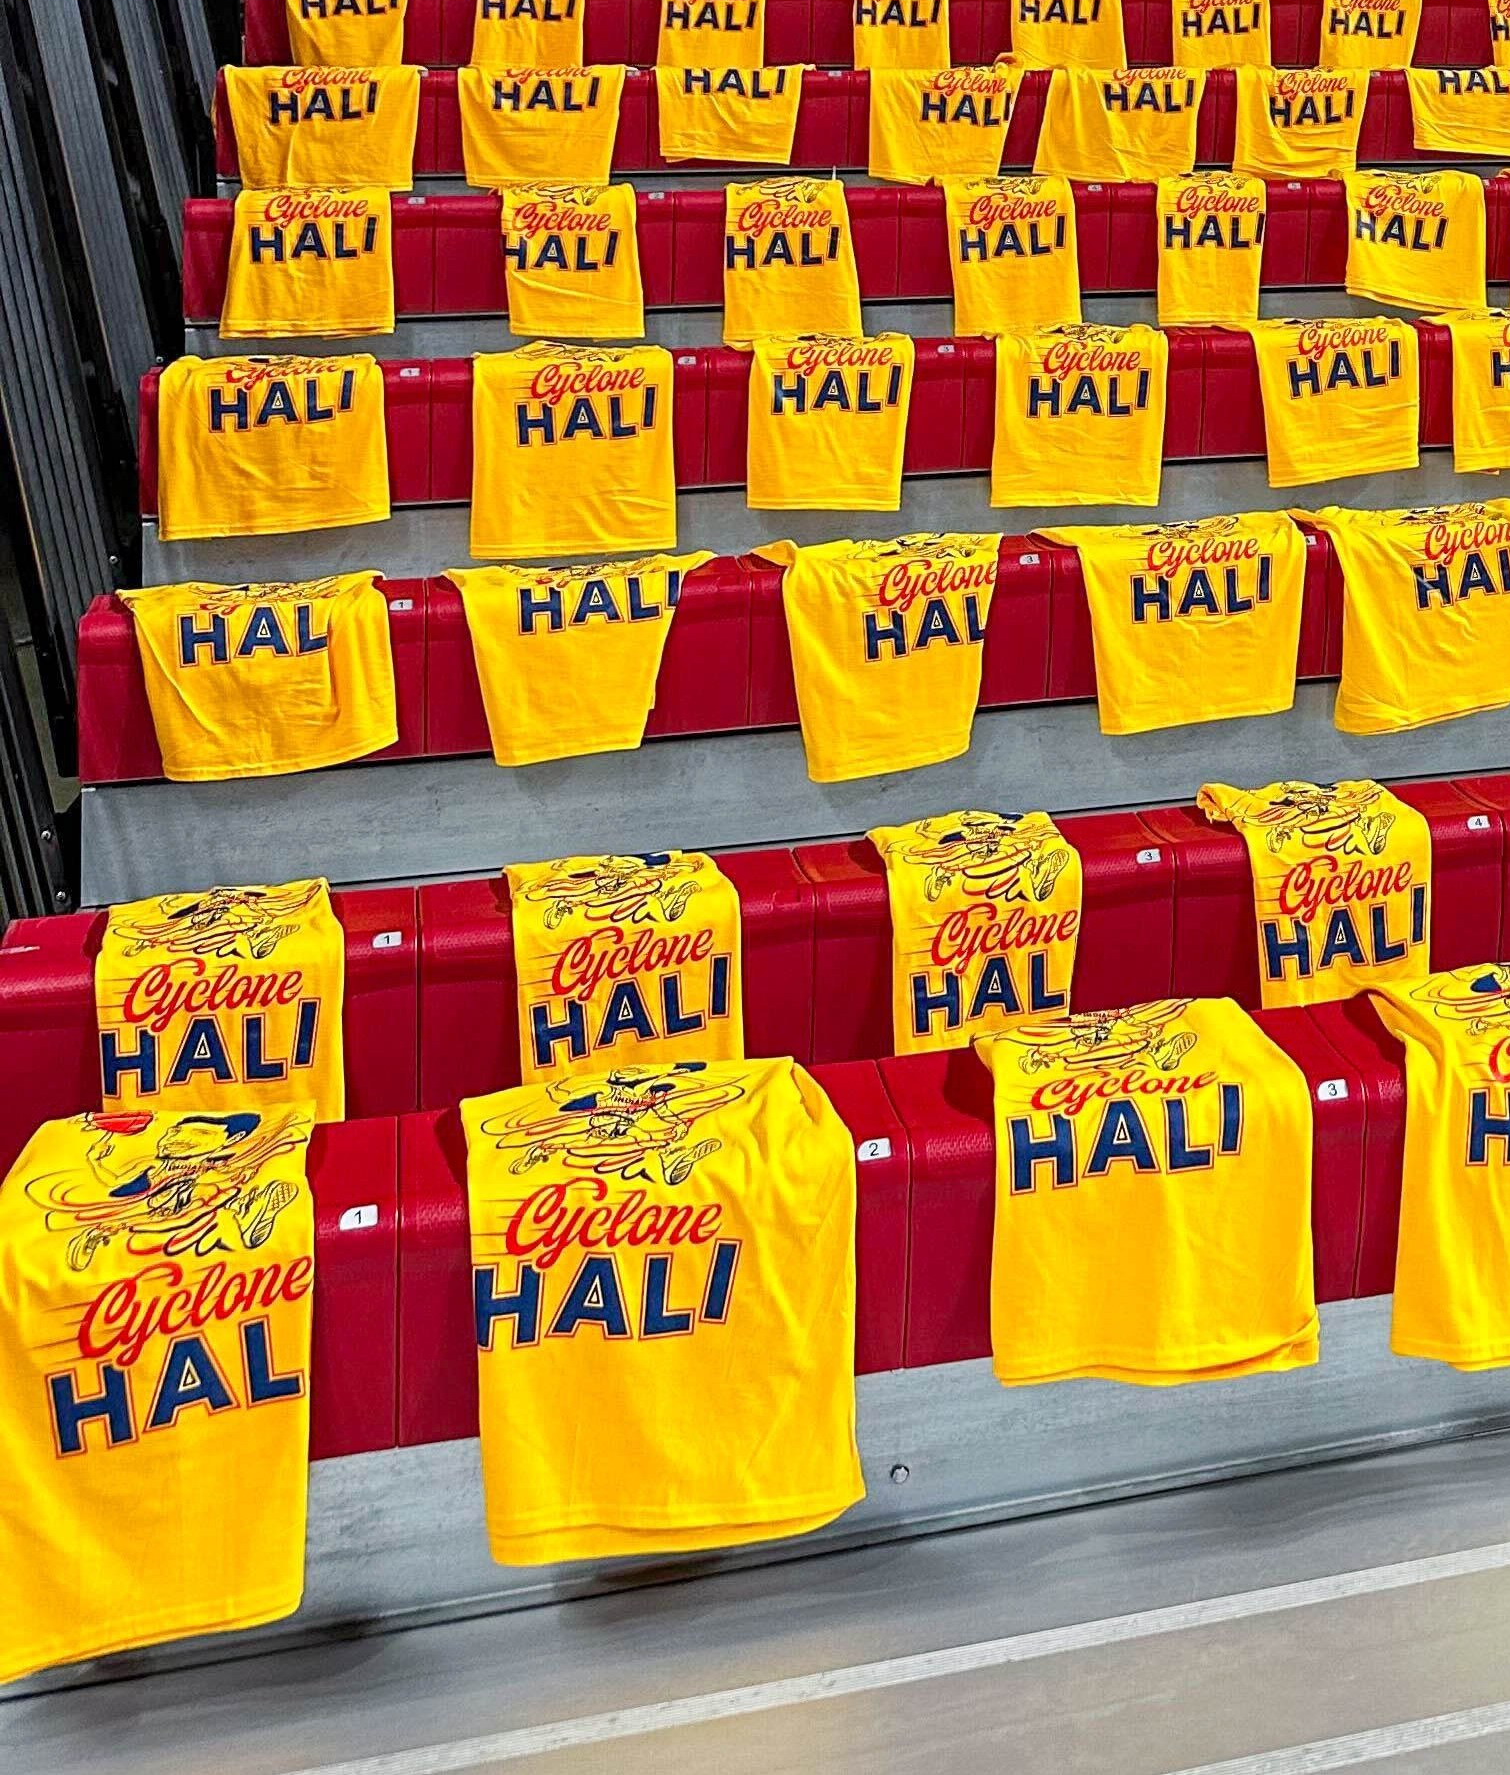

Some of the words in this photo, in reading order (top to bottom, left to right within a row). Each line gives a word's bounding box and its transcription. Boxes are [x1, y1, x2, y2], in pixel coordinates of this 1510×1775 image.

[667, 3, 756, 30] HALI
[494, 80, 598, 111] HALI
[685, 68, 785, 98] HALI
[1104, 83, 1193, 112] HALI
[922, 94, 1010, 126] HALI
[263, 190, 365, 223] Cyclone
[512, 202, 608, 239] Cyclone
[251, 217, 376, 262] HALI
[503, 232, 617, 270] HALI
[726, 228, 839, 268] HALI
[960, 217, 1065, 260] HALI
[1165, 215, 1265, 248] HALI
[786, 347, 887, 374] Cyclone
[1298, 321, 1388, 353] Cyclone
[1041, 342, 1137, 380] Cyclone
[1289, 342, 1399, 396] HALI
[210, 370, 354, 431] HALI
[527, 364, 641, 406] Cyclone
[774, 366, 901, 413] HALI
[1029, 370, 1149, 416] HALI
[517, 387, 655, 445] HALI
[1145, 541, 1254, 576] Cyclone
[875, 559, 1000, 617] Cyclone
[1132, 556, 1270, 621] HALI
[1276, 854, 1411, 918] Cyclone
[930, 901, 1079, 970] Cyclone
[1263, 887, 1425, 978] HALI
[550, 926, 715, 999] Cyclone
[123, 957, 304, 1026] Cyclone
[532, 956, 728, 1065] HALI
[912, 954, 1065, 1033] HAL
[100, 1001, 317, 1095] HALI
[1029, 1070, 1217, 1117] Cyclone
[1011, 1084, 1241, 1191] HALI
[504, 1177, 724, 1258] Cyclone
[78, 1254, 314, 1367] Cyclone
[473, 1243, 737, 1347] HALI
[51, 1321, 300, 1453] HAL
